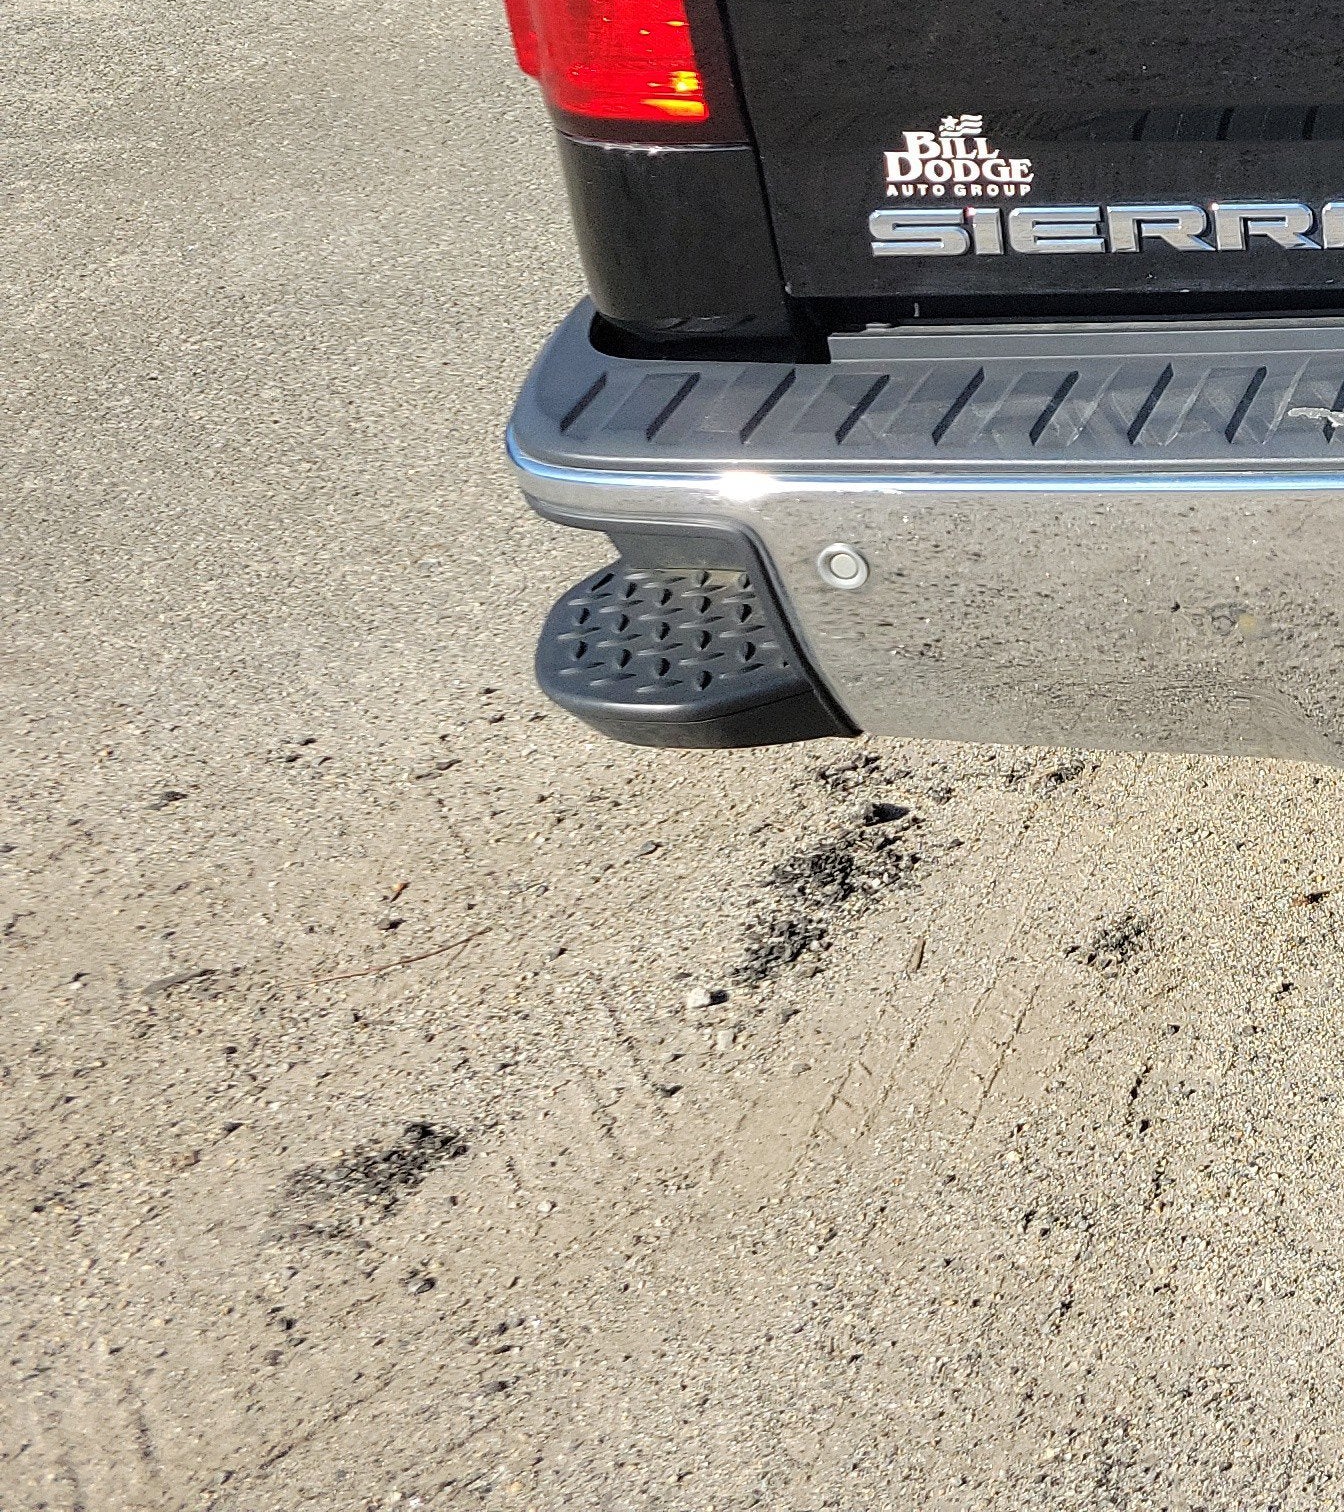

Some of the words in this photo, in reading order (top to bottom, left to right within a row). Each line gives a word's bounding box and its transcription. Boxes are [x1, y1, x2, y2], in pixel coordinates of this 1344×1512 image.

[902, 131, 1000, 160] BILL
[883, 151, 1035, 183] DODGE
[886, 184, 946, 198] AUTO
[953, 184, 1032, 198] GROUP
